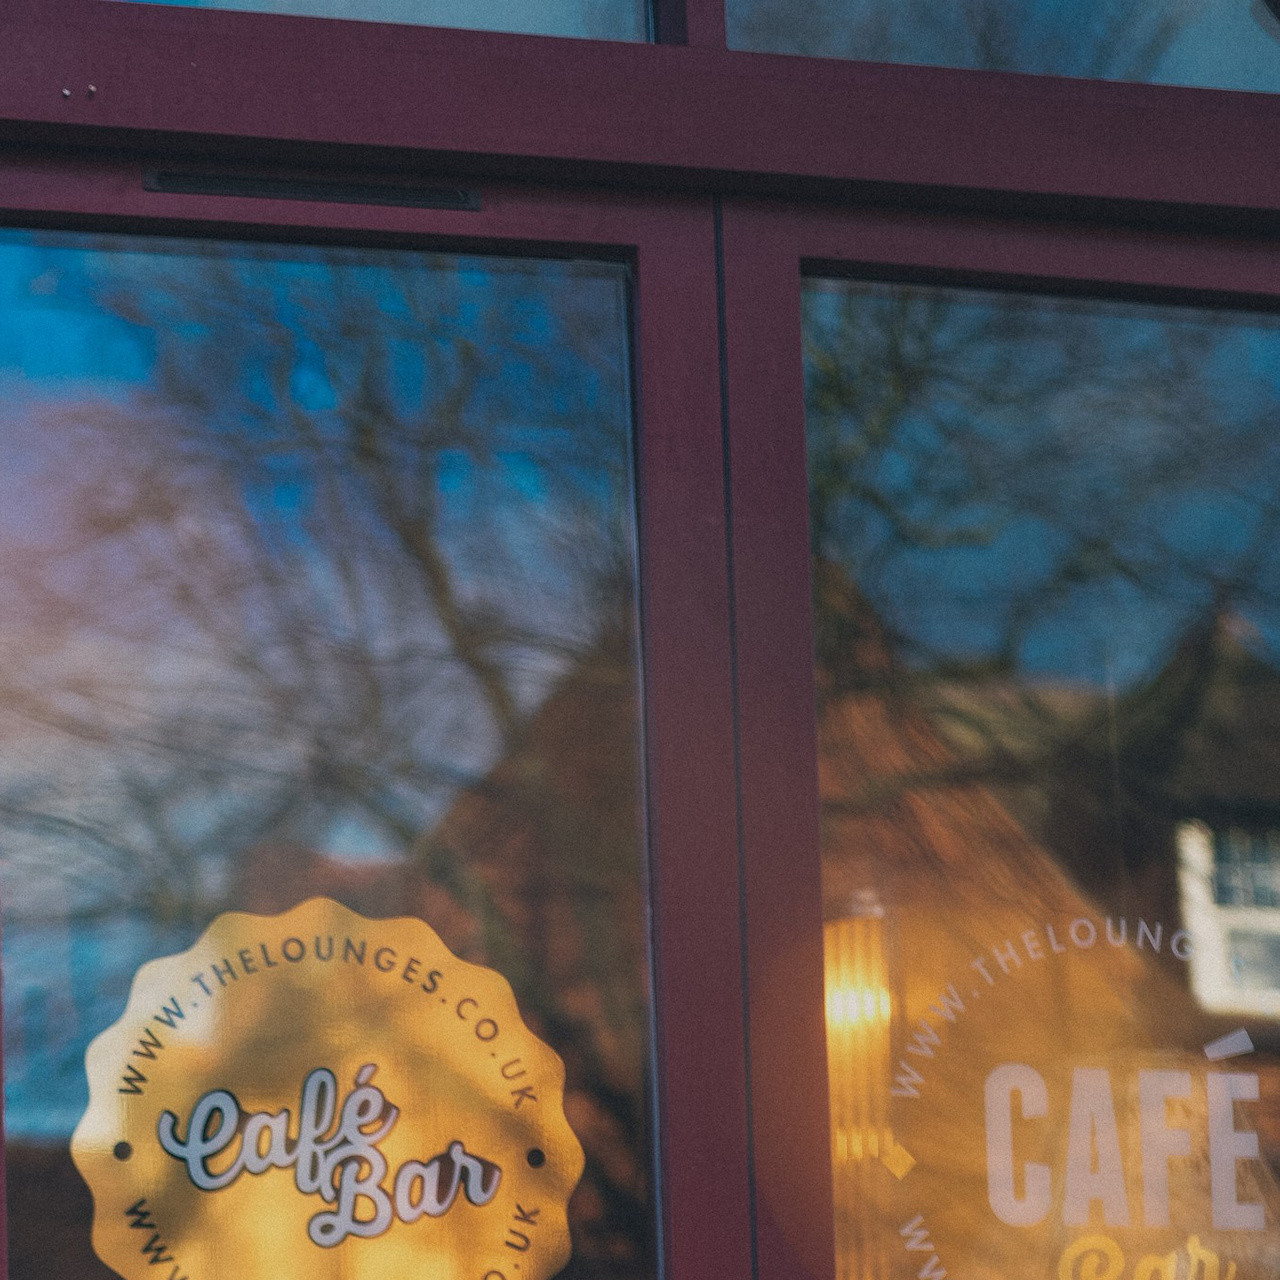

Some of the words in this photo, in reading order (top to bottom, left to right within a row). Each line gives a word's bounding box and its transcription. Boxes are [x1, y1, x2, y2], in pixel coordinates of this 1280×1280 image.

[118, 936, 538, 1110] WWW.THELOUNGES.CO.UK
[158, 1063, 400, 1196] Café
[308, 1141, 503, 1248] Bar
[984, 1027, 1266, 1231] CAFÉ
